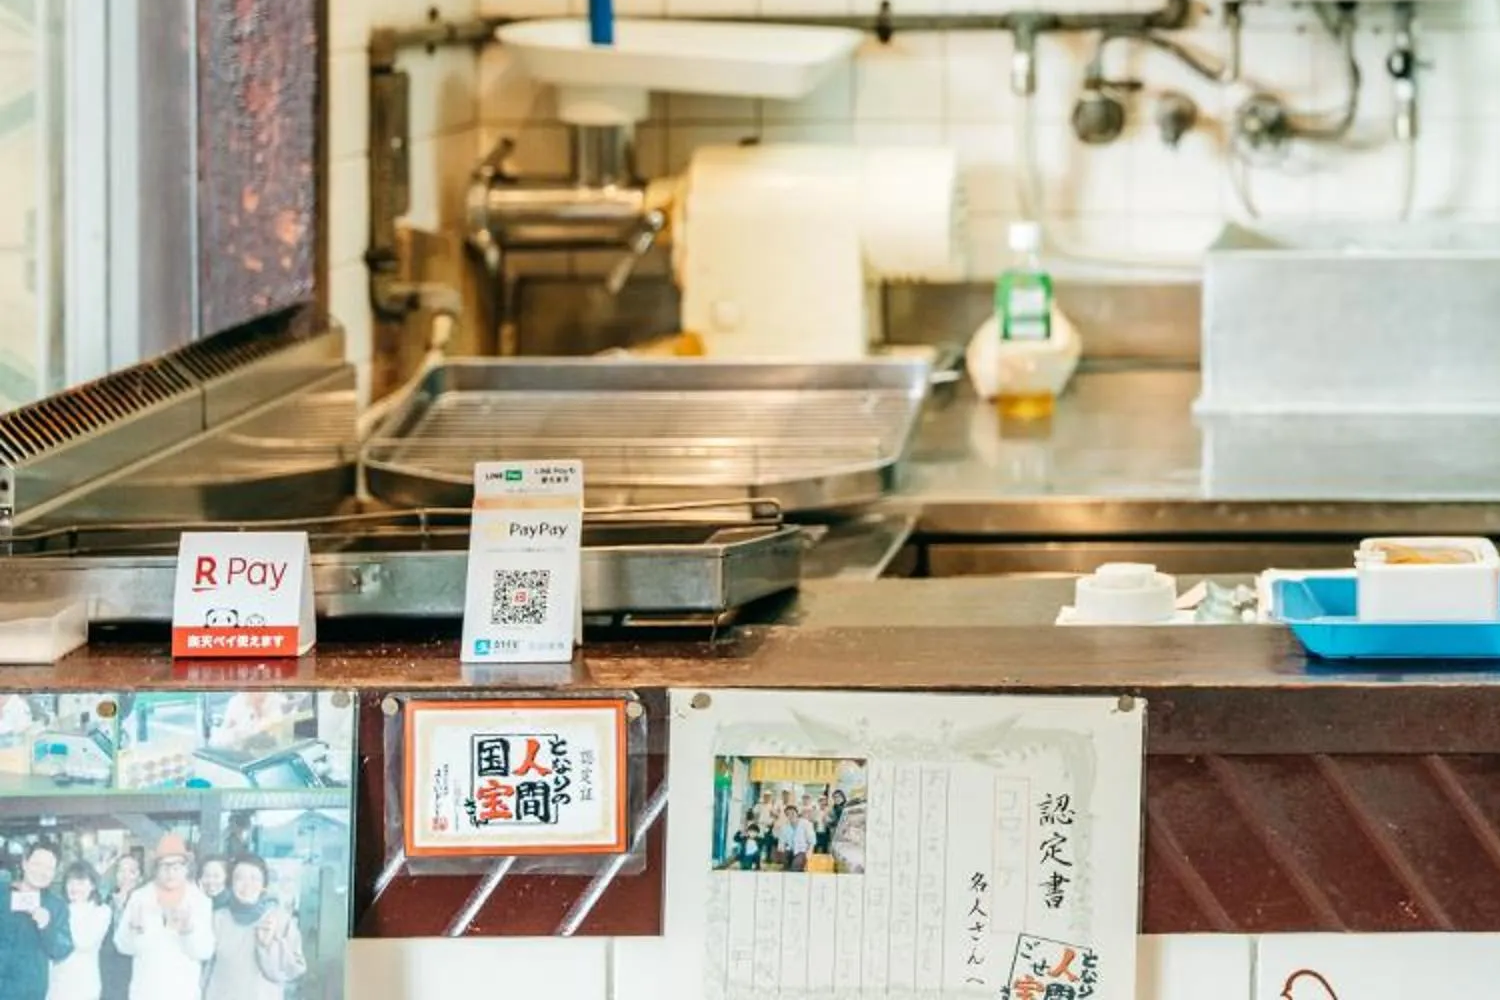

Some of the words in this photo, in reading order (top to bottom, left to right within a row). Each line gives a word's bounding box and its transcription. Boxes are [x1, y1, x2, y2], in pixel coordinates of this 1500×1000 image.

[509, 522, 568, 539] PayPay
[227, 557, 288, 590] Pay
[476, 737, 516, 821] 国宝
[512, 738, 553, 823] 人間
[548, 737, 573, 805] となりの
[1037, 792, 1076, 909] 認定書
[966, 871, 988, 985] 名人さんへ
